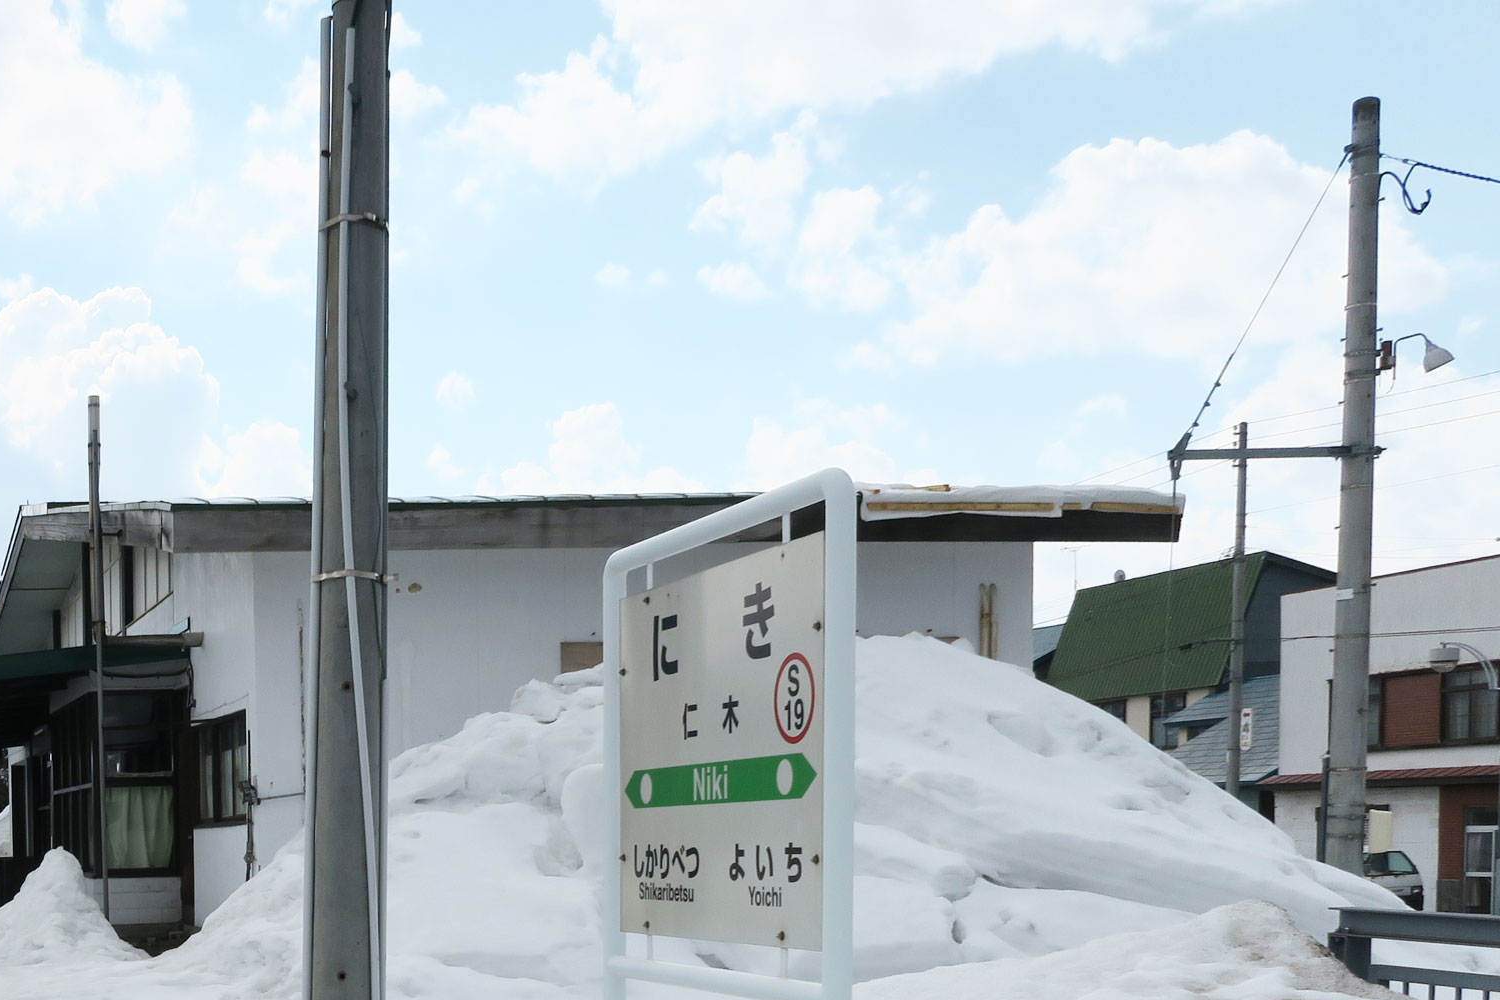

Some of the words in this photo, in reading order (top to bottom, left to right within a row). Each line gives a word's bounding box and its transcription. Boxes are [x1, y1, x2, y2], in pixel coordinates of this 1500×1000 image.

[653, 582, 775, 682] にき
[787, 664, 800, 697] S
[682, 695, 739, 740] 仁木
[784, 698, 805, 731] 19
[693, 764, 729, 801] Niki
[634, 843, 700, 879] しかりべつ
[729, 842, 803, 883] よいち
[638, 881, 694, 903] Shikaribetsu
[748, 886, 782, 908] Yoichi
